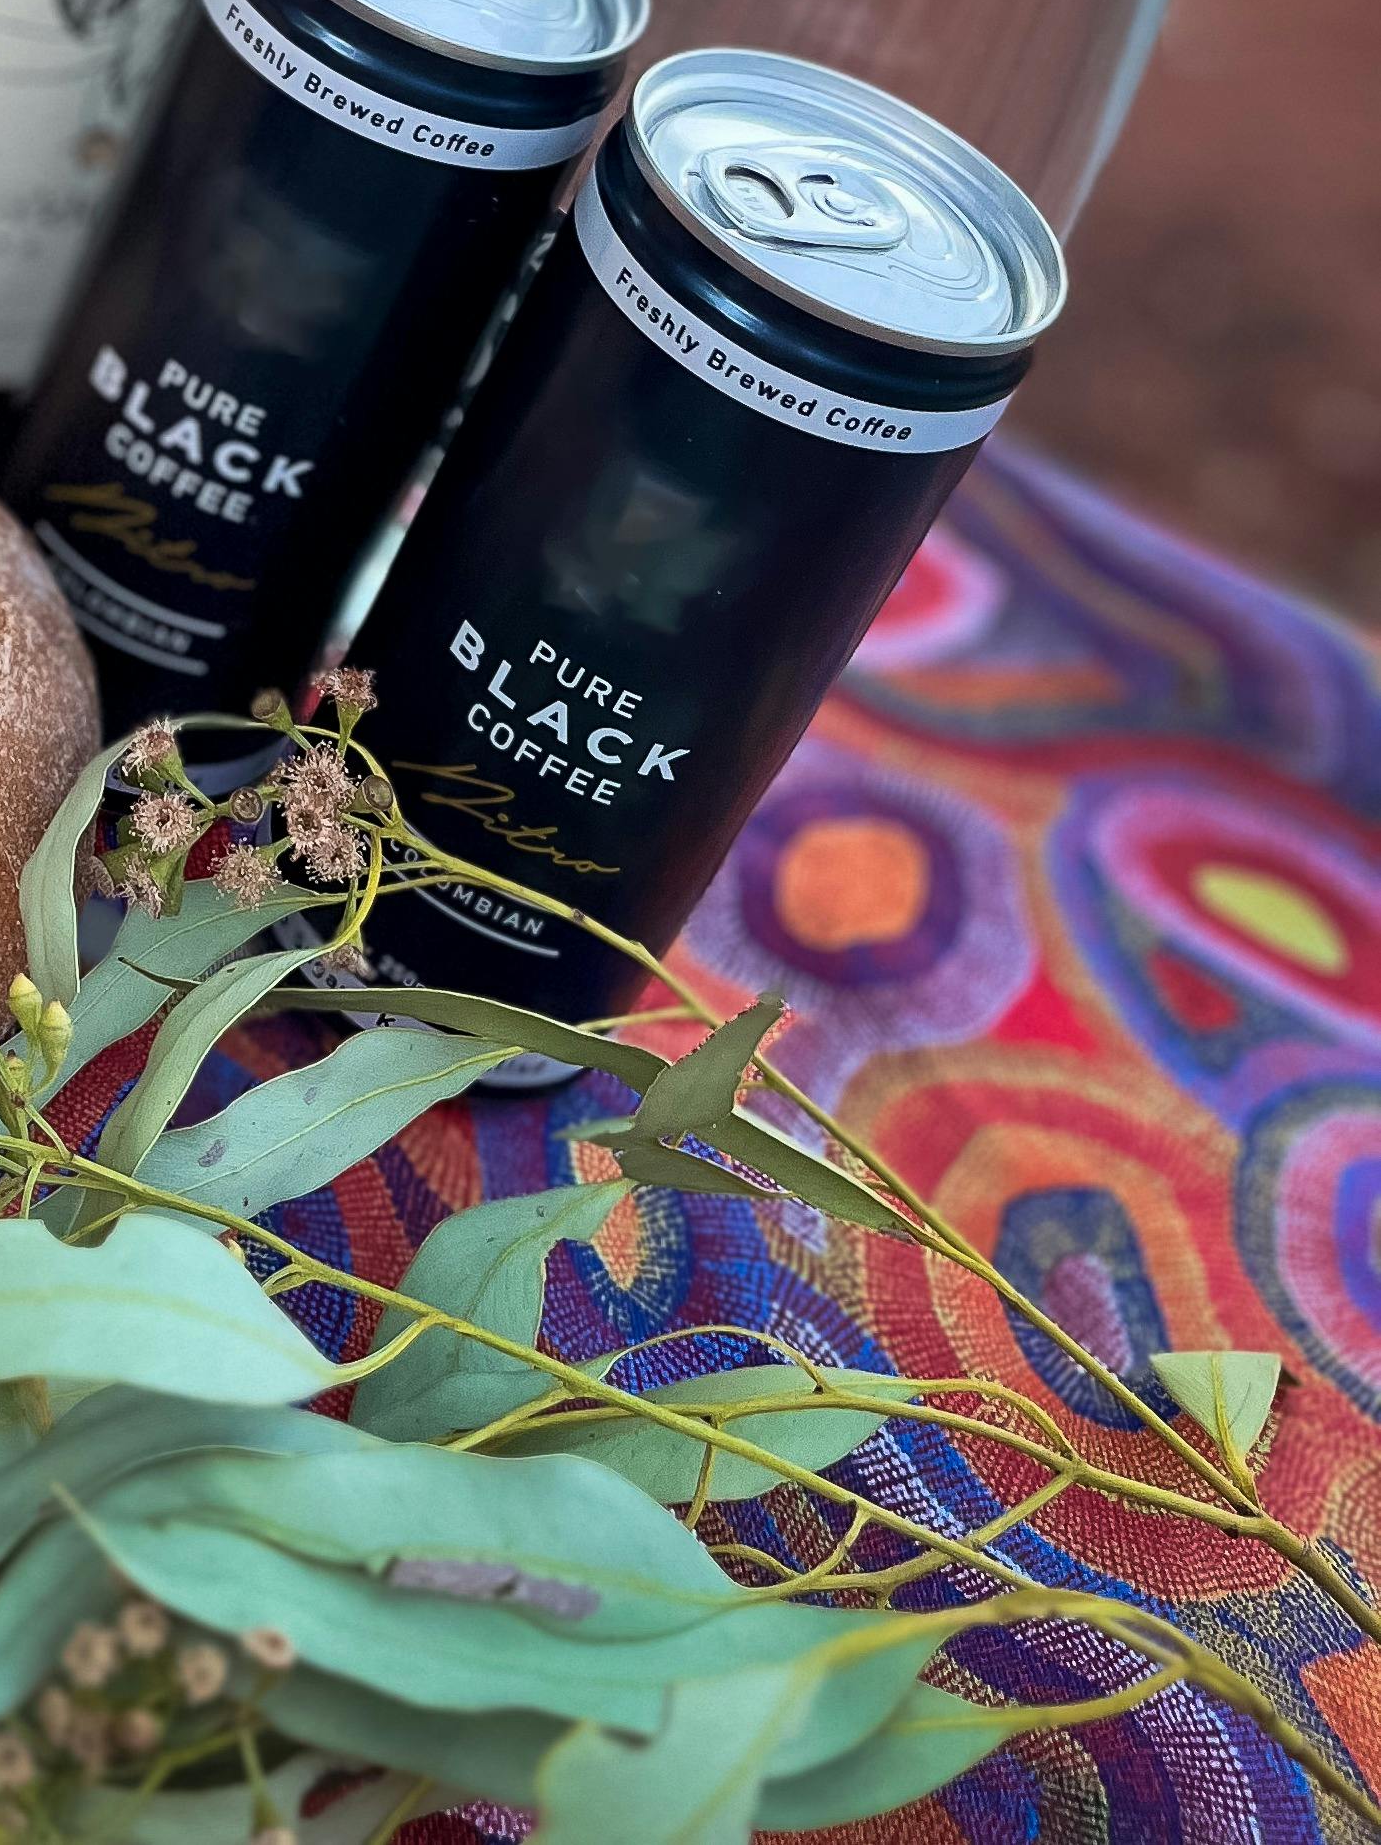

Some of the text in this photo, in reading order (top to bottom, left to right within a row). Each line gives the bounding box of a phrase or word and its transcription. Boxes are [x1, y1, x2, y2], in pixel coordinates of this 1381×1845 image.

[225, 3, 495, 157] Freshly Brewed Coffee
[158, 358, 267, 438] PURE
[616, 267, 912, 441] Freshly Brewed Coffee
[89, 344, 315, 499] BLACK
[105, 422, 255, 523] COFFEE
[450, 619, 691, 781] BLACK
[530, 640, 643, 719] PURE
[467, 703, 622, 806] COFFEE
